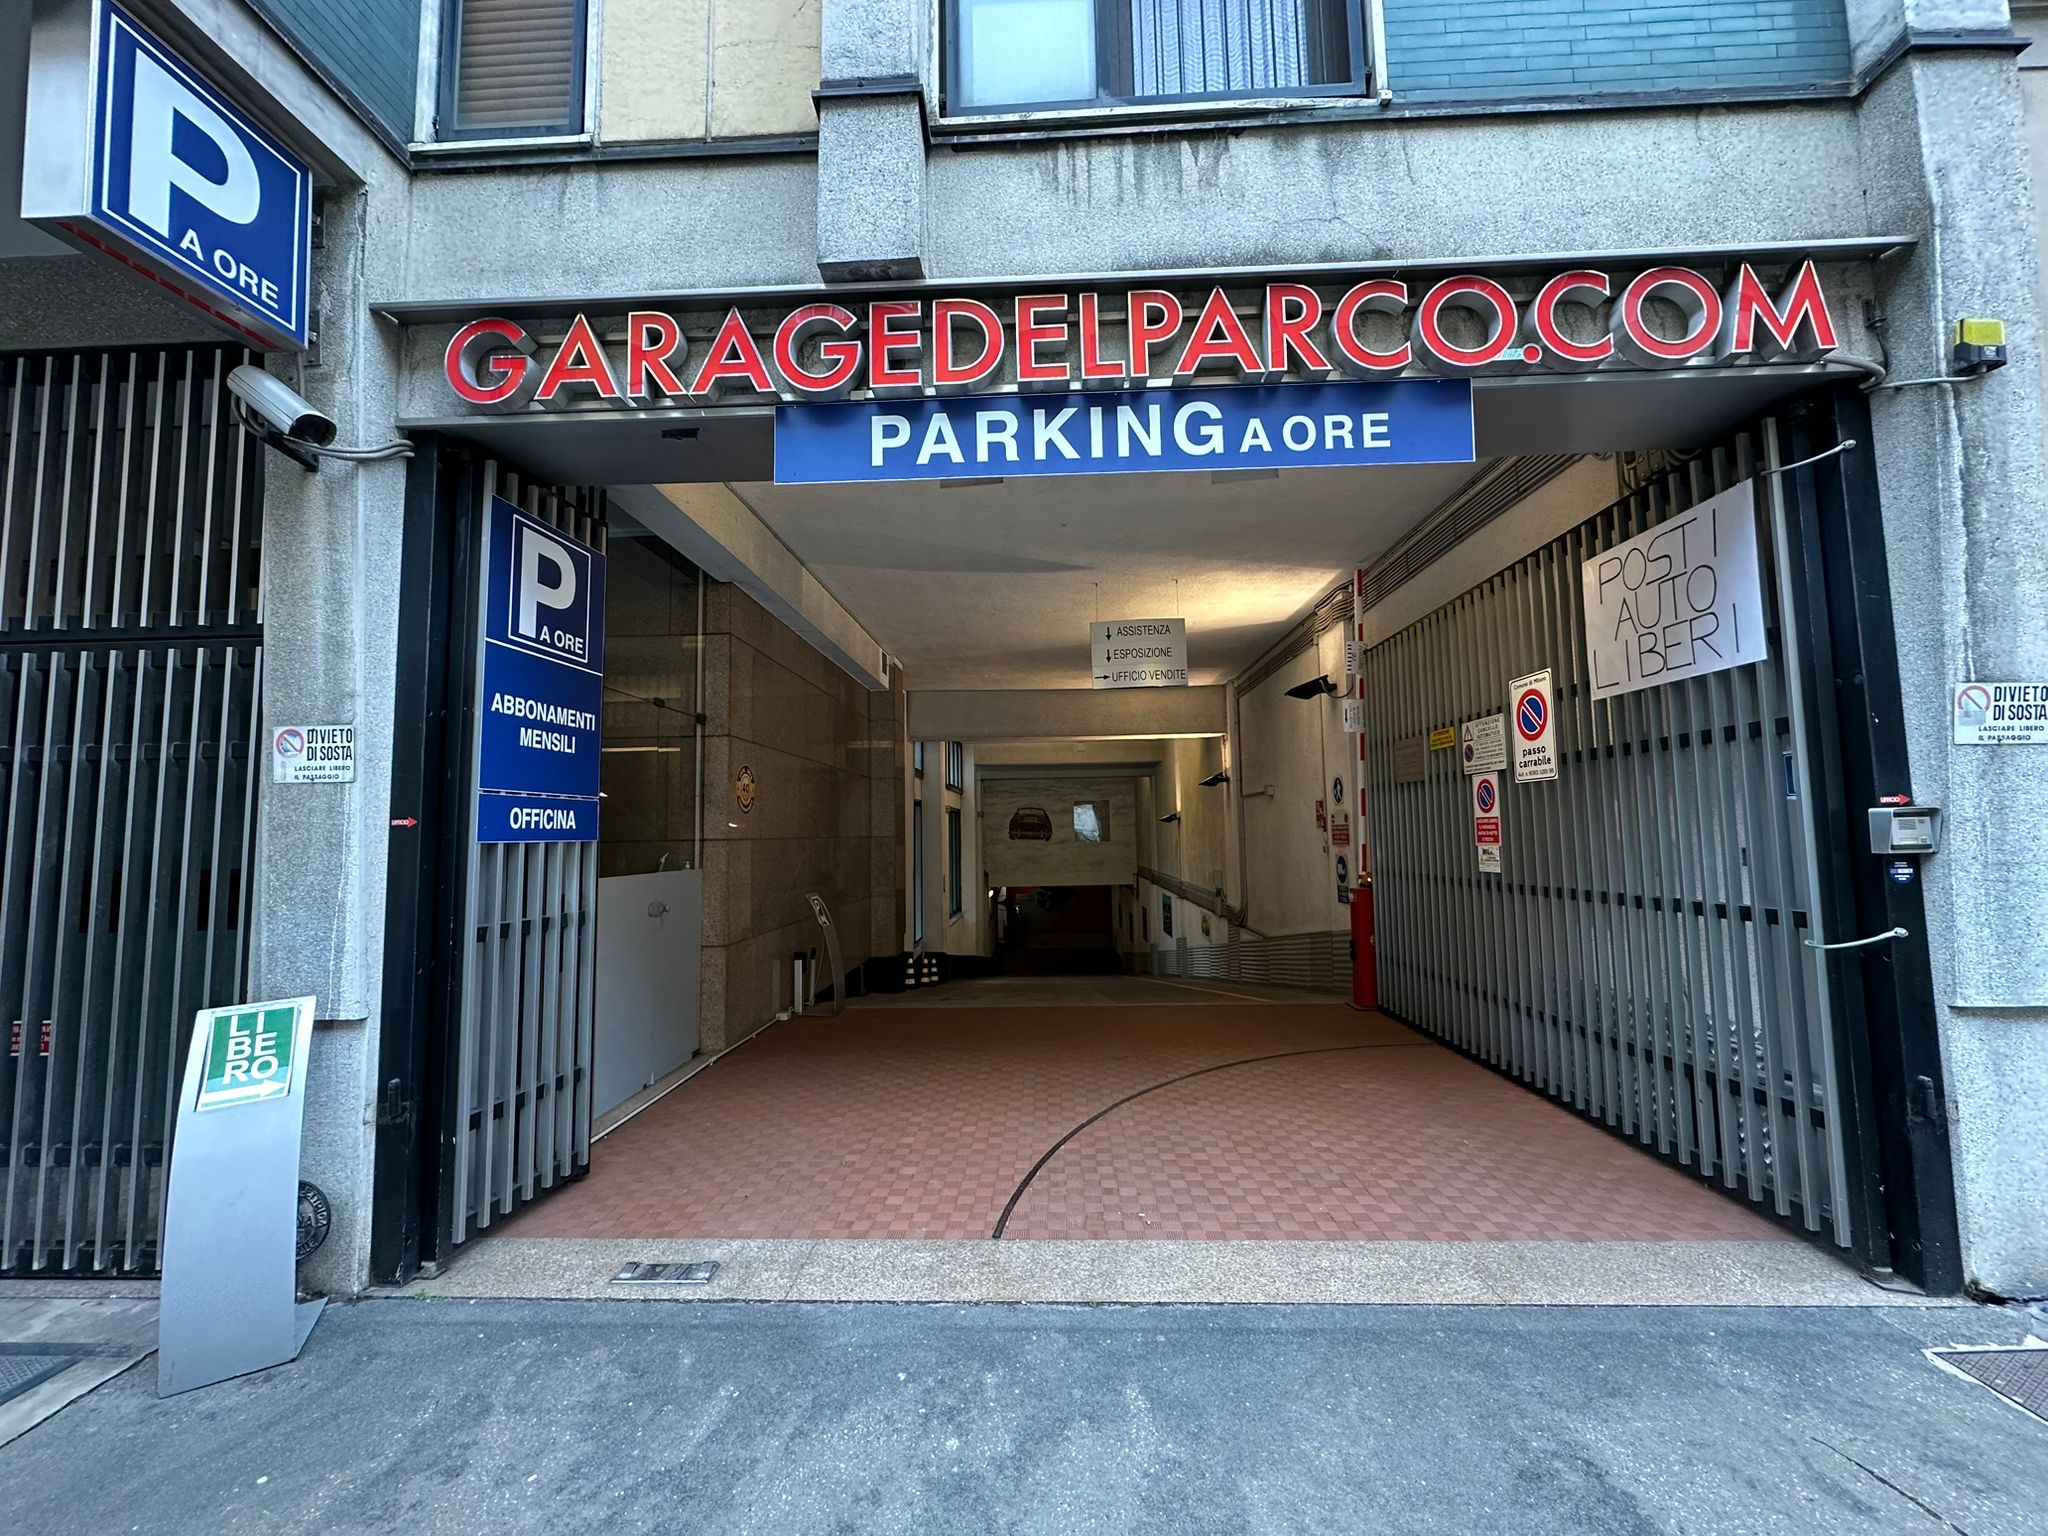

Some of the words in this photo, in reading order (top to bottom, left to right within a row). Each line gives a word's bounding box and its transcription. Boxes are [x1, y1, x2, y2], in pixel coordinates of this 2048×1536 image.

[128, 47, 261, 239] P
[179, 228, 204, 261] A
[213, 249, 279, 309] ORE
[443, 258, 1838, 406] GARAGEDELPARCO.COM
[870, 400, 1225, 467] PARKING
[1239, 416, 1273, 454] A
[1282, 411, 1392, 452] ORE
[1598, 508, 1717, 605] POSTI
[518, 526, 577, 638] P
[1614, 564, 1717, 642] AUTO
[539, 625, 551, 644] A
[554, 630, 584, 654] ORE
[1116, 624, 1171, 637] ASSISTENZA
[1113, 646, 1173, 660] ESPOSIZIONE
[1593, 602, 1740, 690] LIBERI
[1111, 670, 1147, 682] UFFICIO
[1148, 668, 1186, 681] VENDITE
[1993, 685, 2048, 702] DIVIETO
[490, 692, 596, 732] ABBONAMENTI
[1993, 704, 2005, 721] DI
[2008, 703, 2048, 721] SOSTA
[306, 728, 353, 745] DIVIETO
[519, 726, 576, 754] MENSILI
[1988, 734, 2032, 742] PASSAGGIO
[306, 745, 318, 761] DI
[319, 745, 353, 761] SOSTA
[1518, 754, 1552, 769] carrabile
[1522, 745, 1547, 758] passo
[302, 773, 340, 781] PASSAGGIO
[329, 764, 351, 772] LIBERO
[509, 807, 577, 830] OFFICINA
[229, 1010, 265, 1037] LI
[226, 1031, 278, 1061] BE
[222, 1055, 279, 1085] RO
